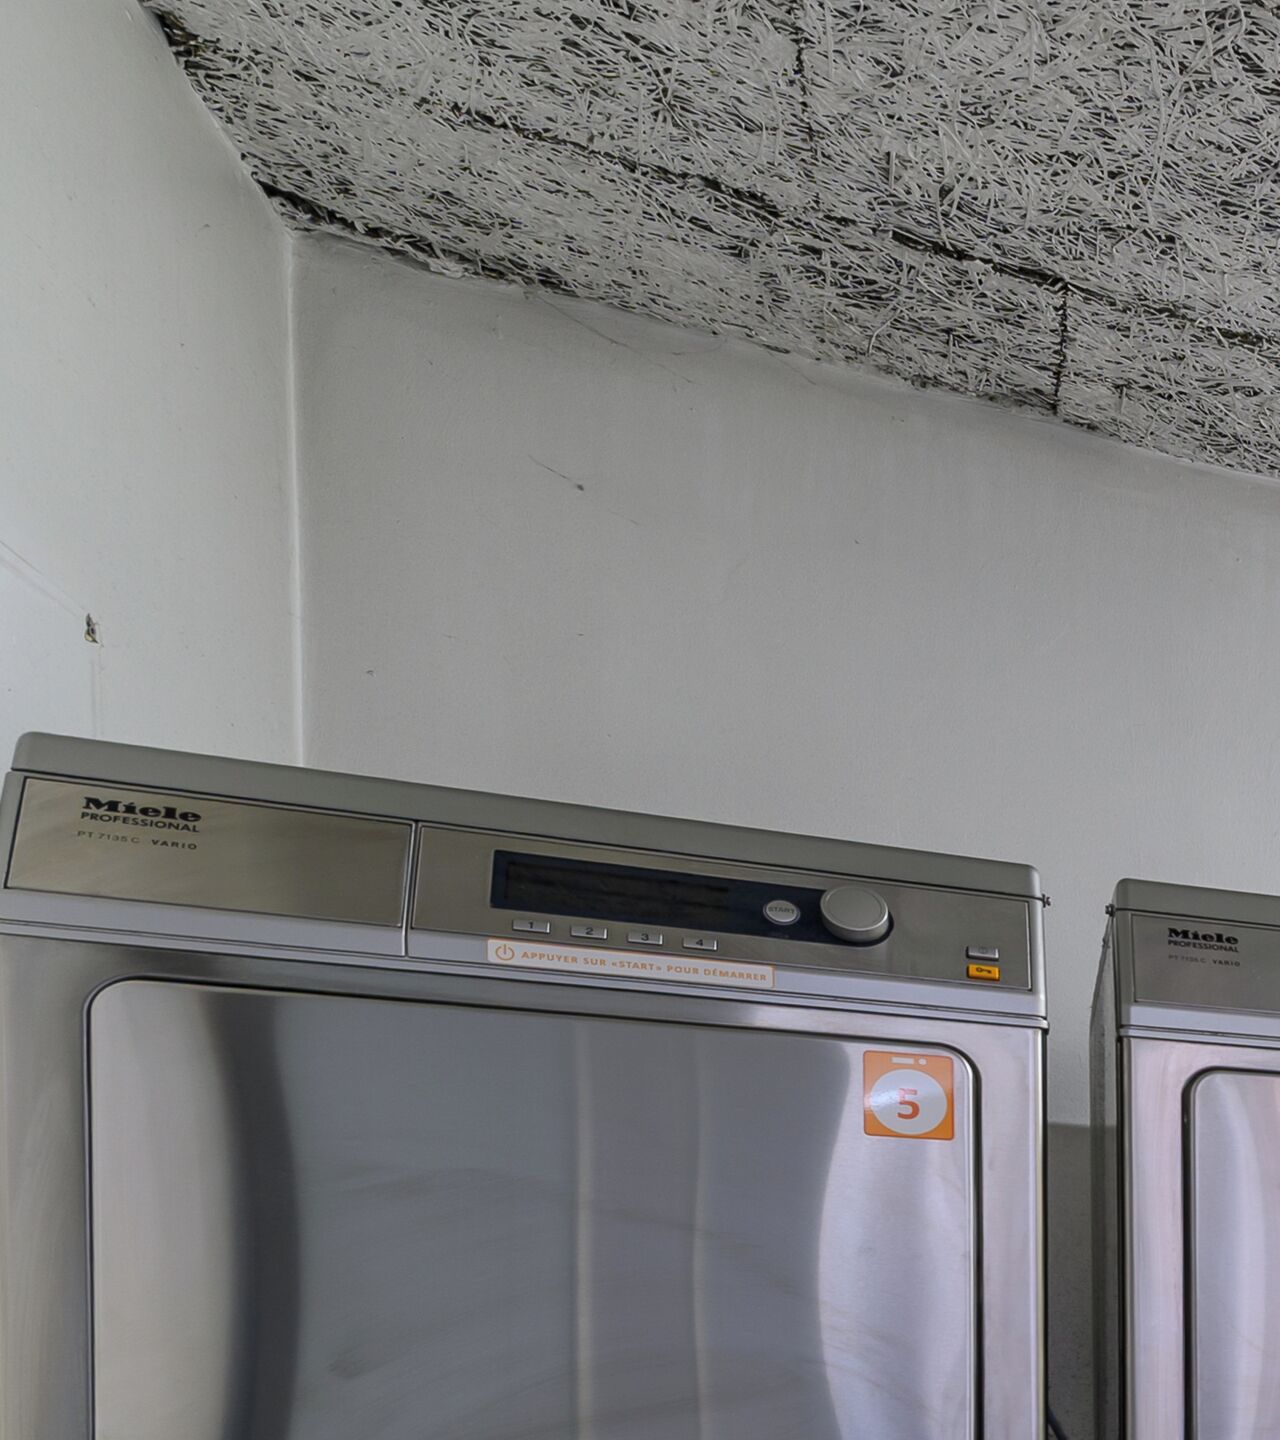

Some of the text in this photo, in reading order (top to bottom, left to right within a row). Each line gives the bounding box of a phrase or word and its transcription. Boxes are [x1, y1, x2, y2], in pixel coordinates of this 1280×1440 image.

[83, 797, 201, 822] Miele
[81, 812, 199, 832] PROFESSIONAL
[152, 840, 197, 850] VARIO
[768, 906, 795, 914] START
[586, 927, 593, 935] 2
[1168, 927, 1238, 944] Miele
[1168, 939, 1238, 952] PROFESSIONAL
[521, 951, 767, 981] APPUYER SUR «START» POUR DÉMARRER
[897, 1088, 920, 1120] 5
